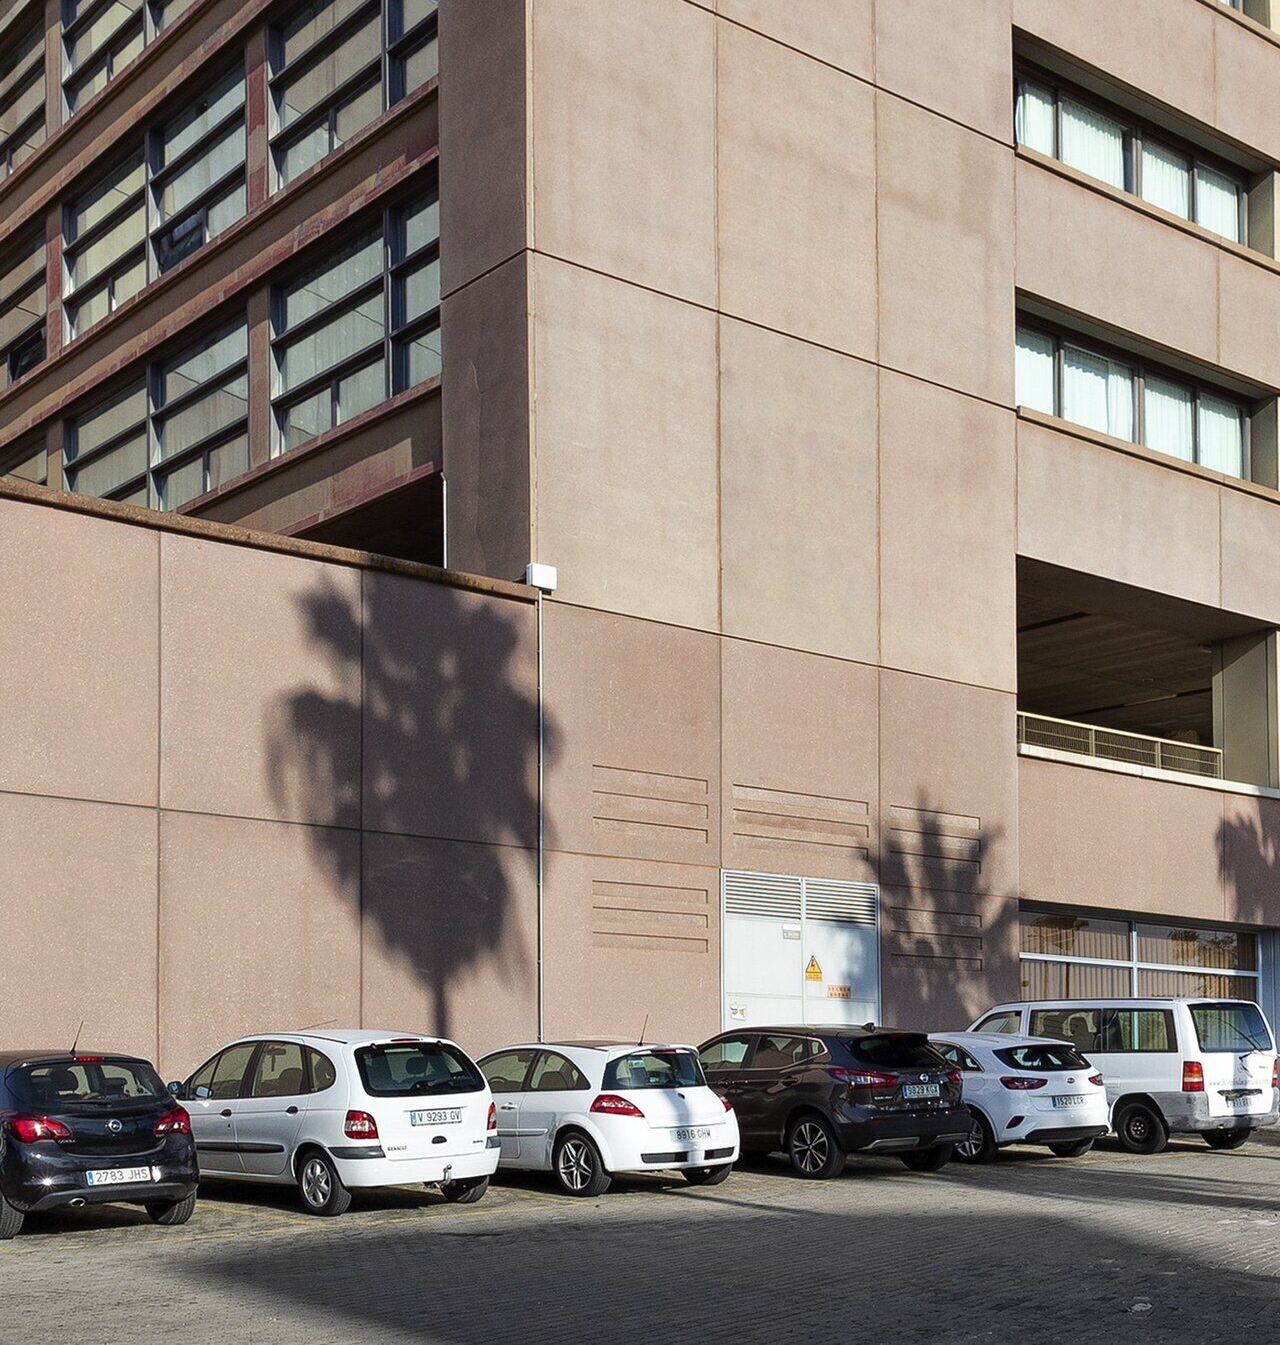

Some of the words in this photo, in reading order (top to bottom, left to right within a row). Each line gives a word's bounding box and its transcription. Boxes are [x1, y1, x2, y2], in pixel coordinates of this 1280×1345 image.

[1056, 1097, 1072, 1106] 1520
[427, 1111, 447, 1122] 9293
[450, 1110, 461, 1120] GV
[676, 1130, 696, 1140] 8916
[96, 1170, 124, 1183] 2783
[128, 1168, 148, 1180] JHS
